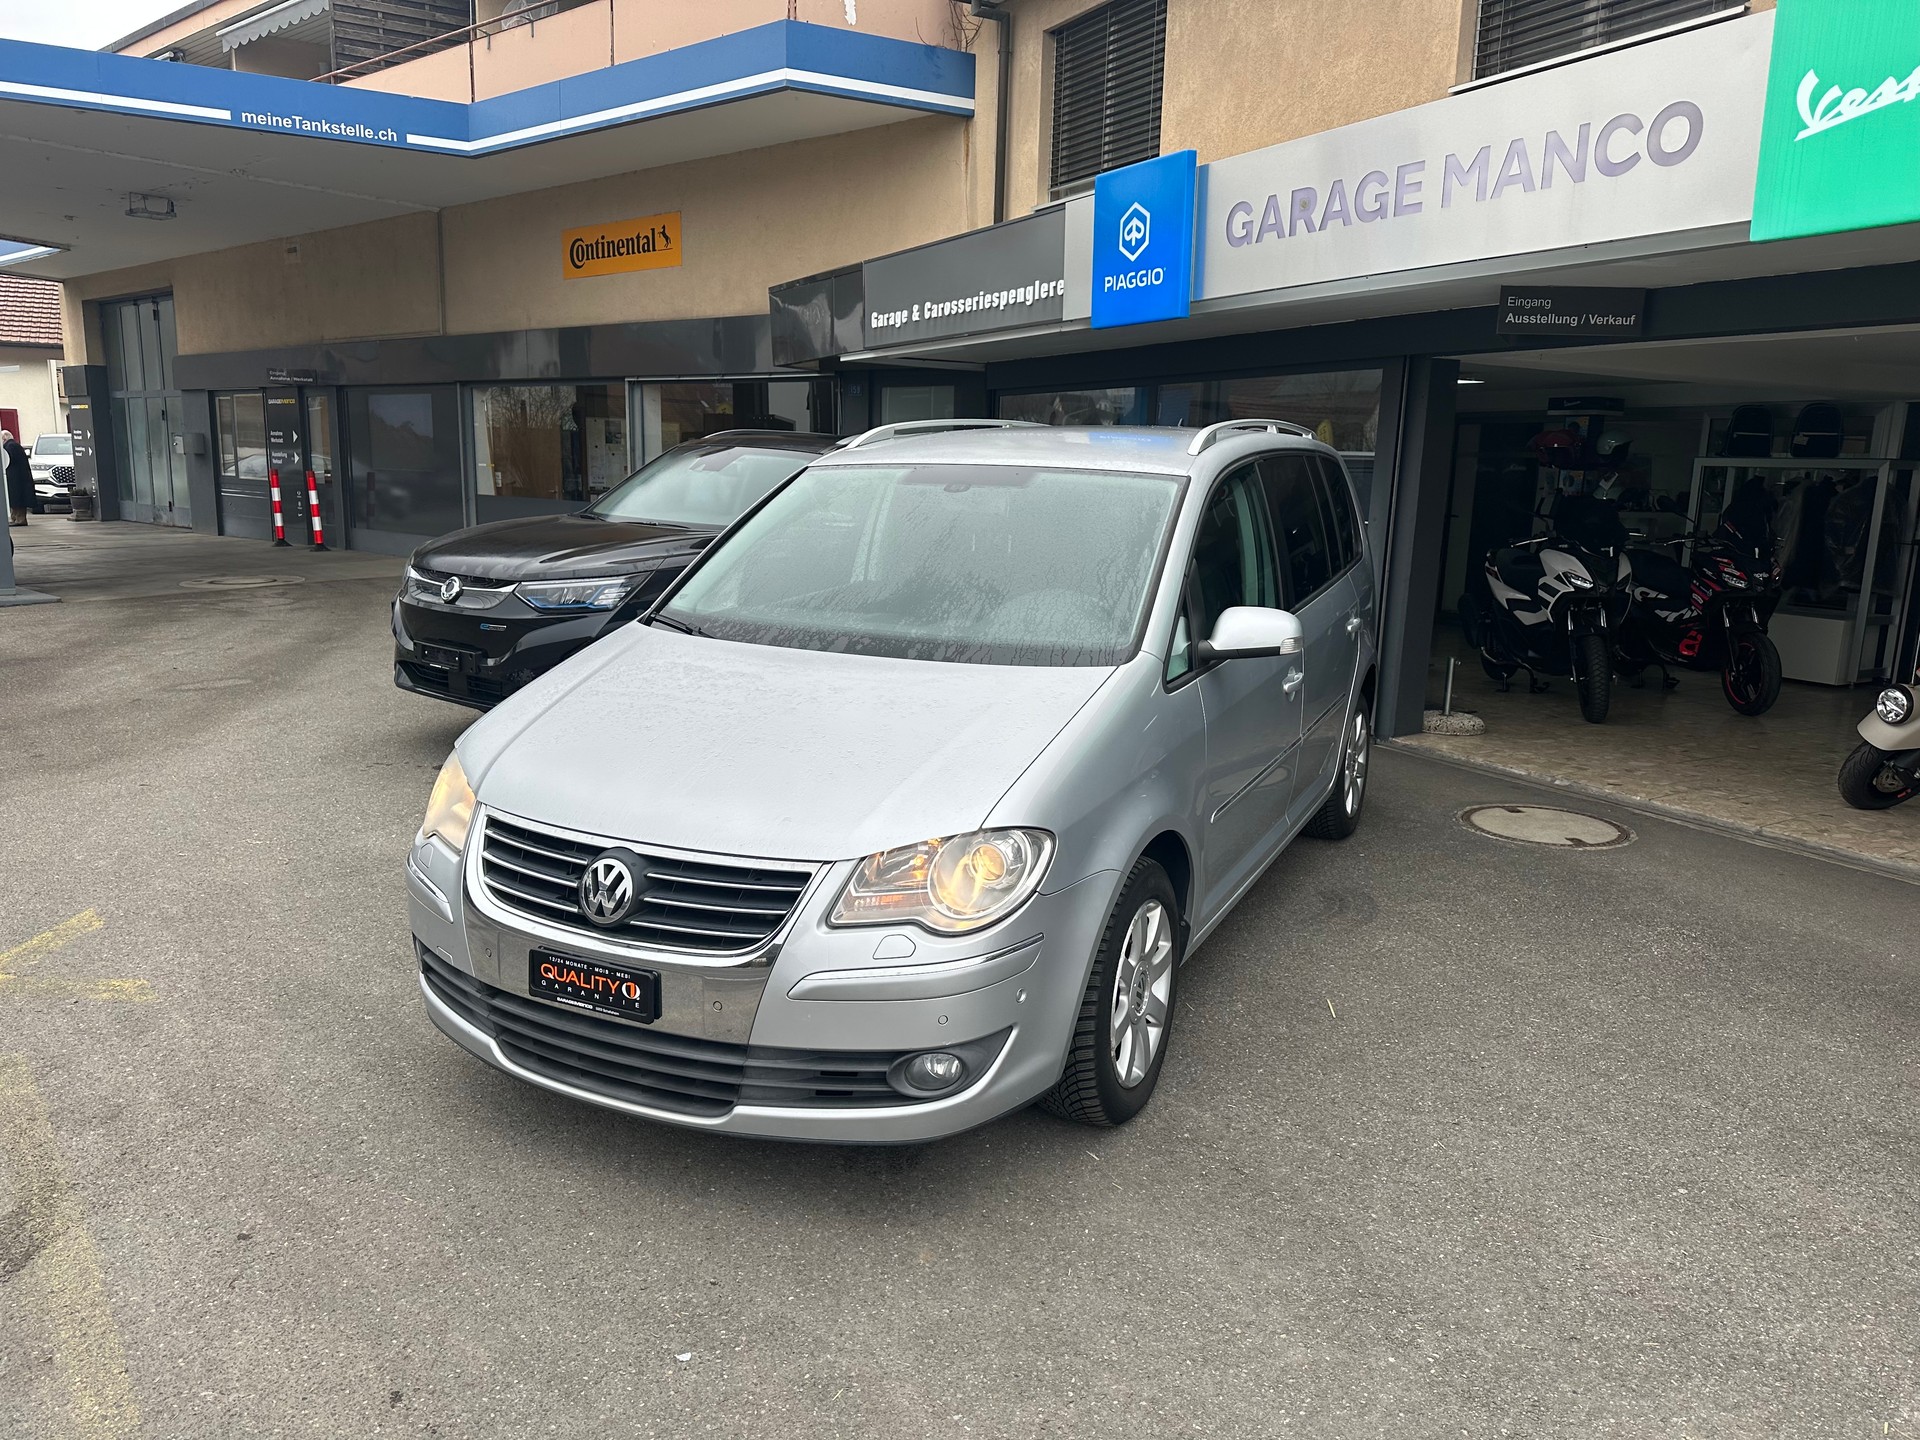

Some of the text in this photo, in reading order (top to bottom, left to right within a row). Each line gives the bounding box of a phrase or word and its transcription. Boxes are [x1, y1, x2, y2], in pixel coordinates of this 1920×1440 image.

[241, 111, 397, 142] meineTankstelle.ch
[1226, 100, 1704, 248] GARAGE MANCO
[569, 227, 657, 269] Continental
[1104, 268, 1164, 292] PIAGGIO
[871, 305, 908, 329] Garage
[912, 304, 920, 322] &
[1507, 296, 1552, 309] Eingang
[1505, 312, 1636, 327] Ausstellung / Verkauf
[540, 963, 620, 994] QUALITY
